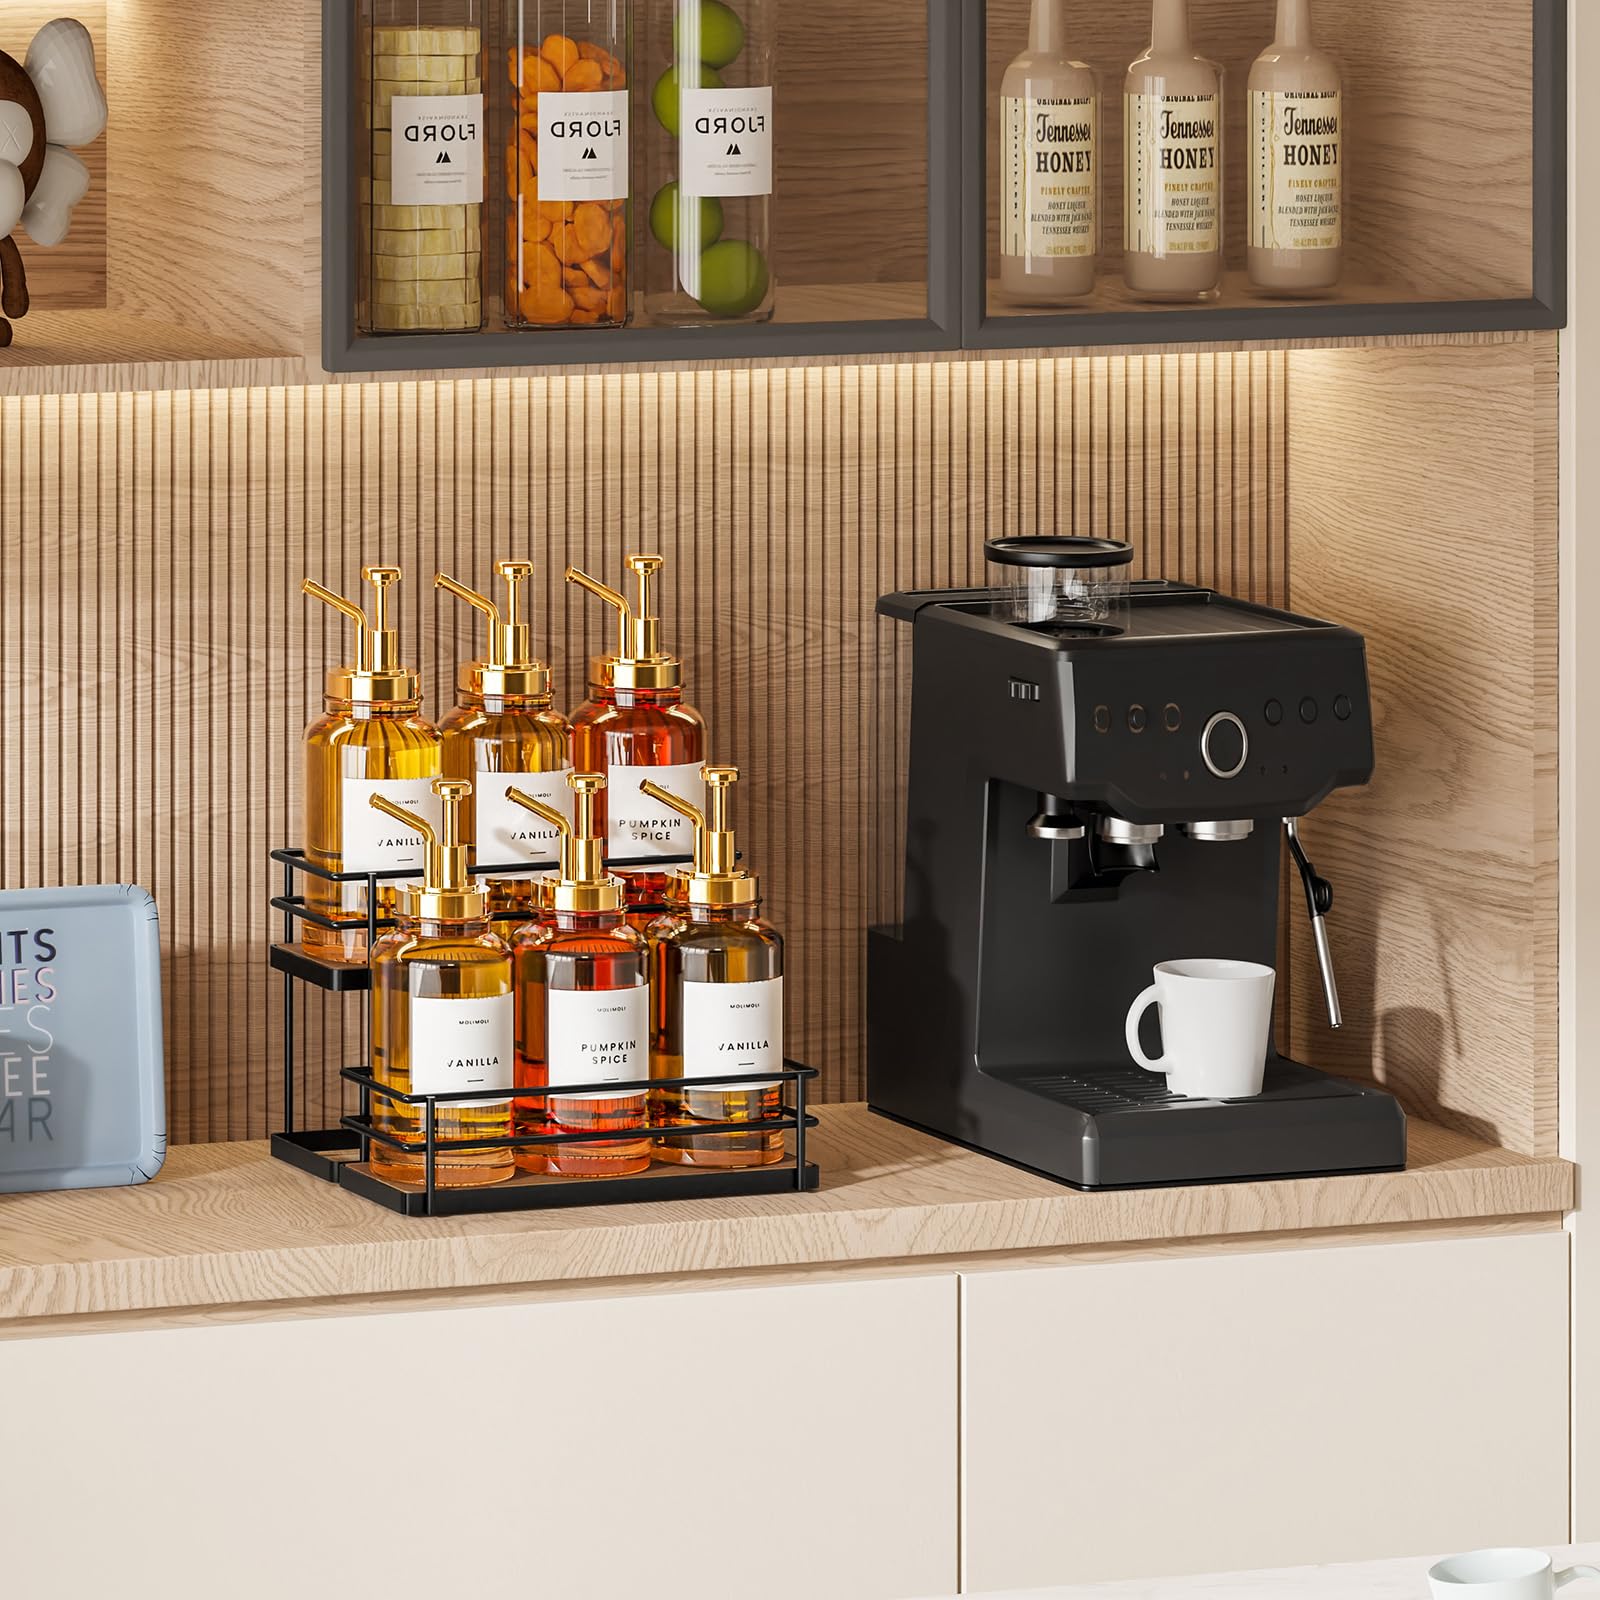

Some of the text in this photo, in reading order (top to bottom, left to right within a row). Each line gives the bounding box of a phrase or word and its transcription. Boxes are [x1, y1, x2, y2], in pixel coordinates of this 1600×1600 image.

[1160, 147, 1214, 169] HONEY
[1283, 143, 1337, 166] HONEY
[1035, 151, 1091, 173] HONEY
[1171, 198, 1189, 206] HONEY
[1295, 194, 1313, 202] HONEY
[1047, 201, 1066, 210] HONEY
[1278, 206, 1303, 214] BLENDED
[1303, 206, 1318, 214] WITH
[1031, 213, 1055, 222] BLENDED
[1056, 213, 1071, 222] WITH
[1154, 210, 1179, 218] BLENDED
[1180, 209, 1194, 218] WITH
[1166, 222, 1195, 231] TENNESSEE
[1289, 218, 1319, 227] TENNESSEE
[1042, 226, 1071, 235] TENNESSEE
[619, 818, 681, 828] PUMPKIN
[511, 830, 560, 840] VANILLA
[631, 831, 671, 841] SPICE
[377, 837, 425, 847] VANILL
[0, 928, 57, 965] TS
[581, 1040, 636, 1052] PUMPKIN
[718, 1040, 769, 1051] VANILLA
[447, 1056, 499, 1068] VANILLA
[592, 1054, 628, 1065] SPICE
